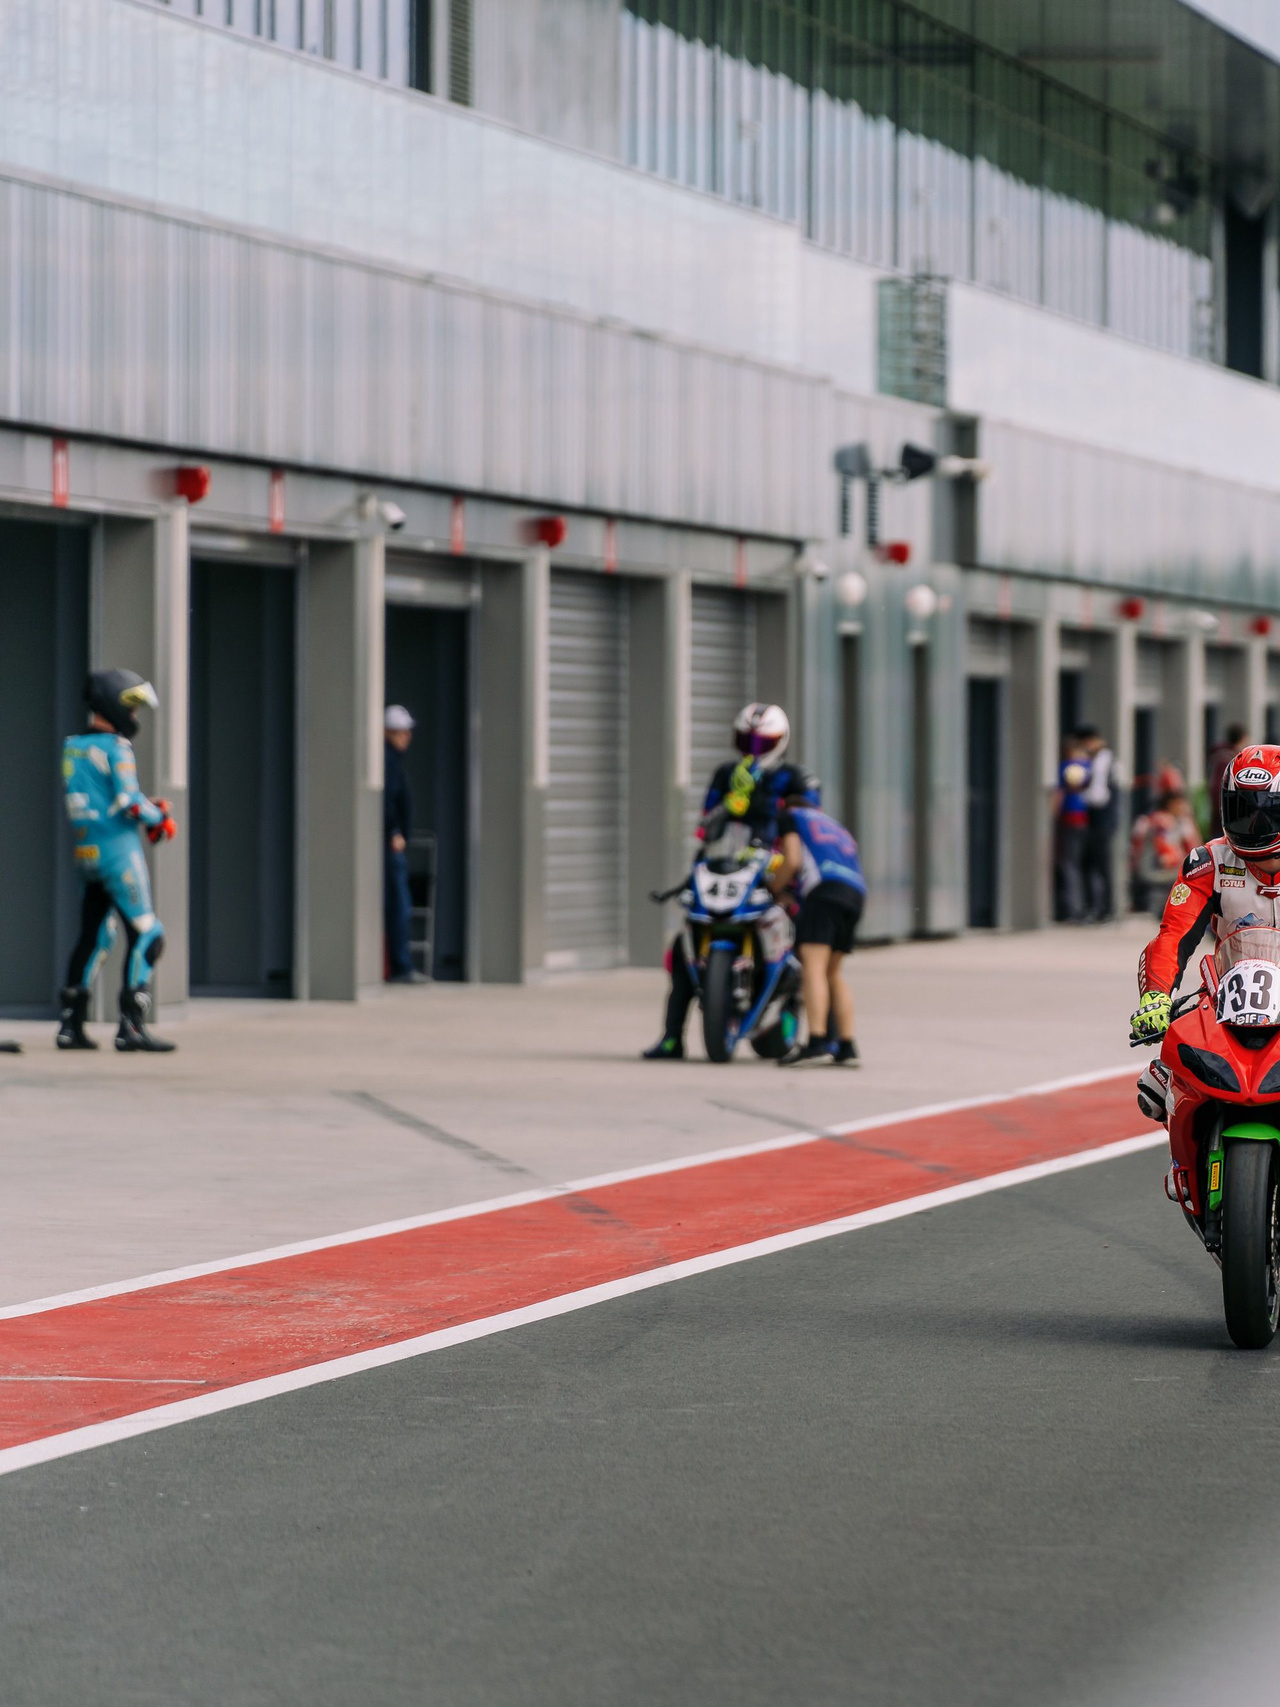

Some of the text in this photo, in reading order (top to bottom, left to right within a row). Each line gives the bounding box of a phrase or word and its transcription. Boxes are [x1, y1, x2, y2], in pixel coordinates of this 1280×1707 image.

[1239, 770, 1266, 780] Arai
[1186, 861, 1212, 878] REWIN
[1139, 951, 1147, 994] RUSSI
[1236, 1014, 1257, 1025] elf
